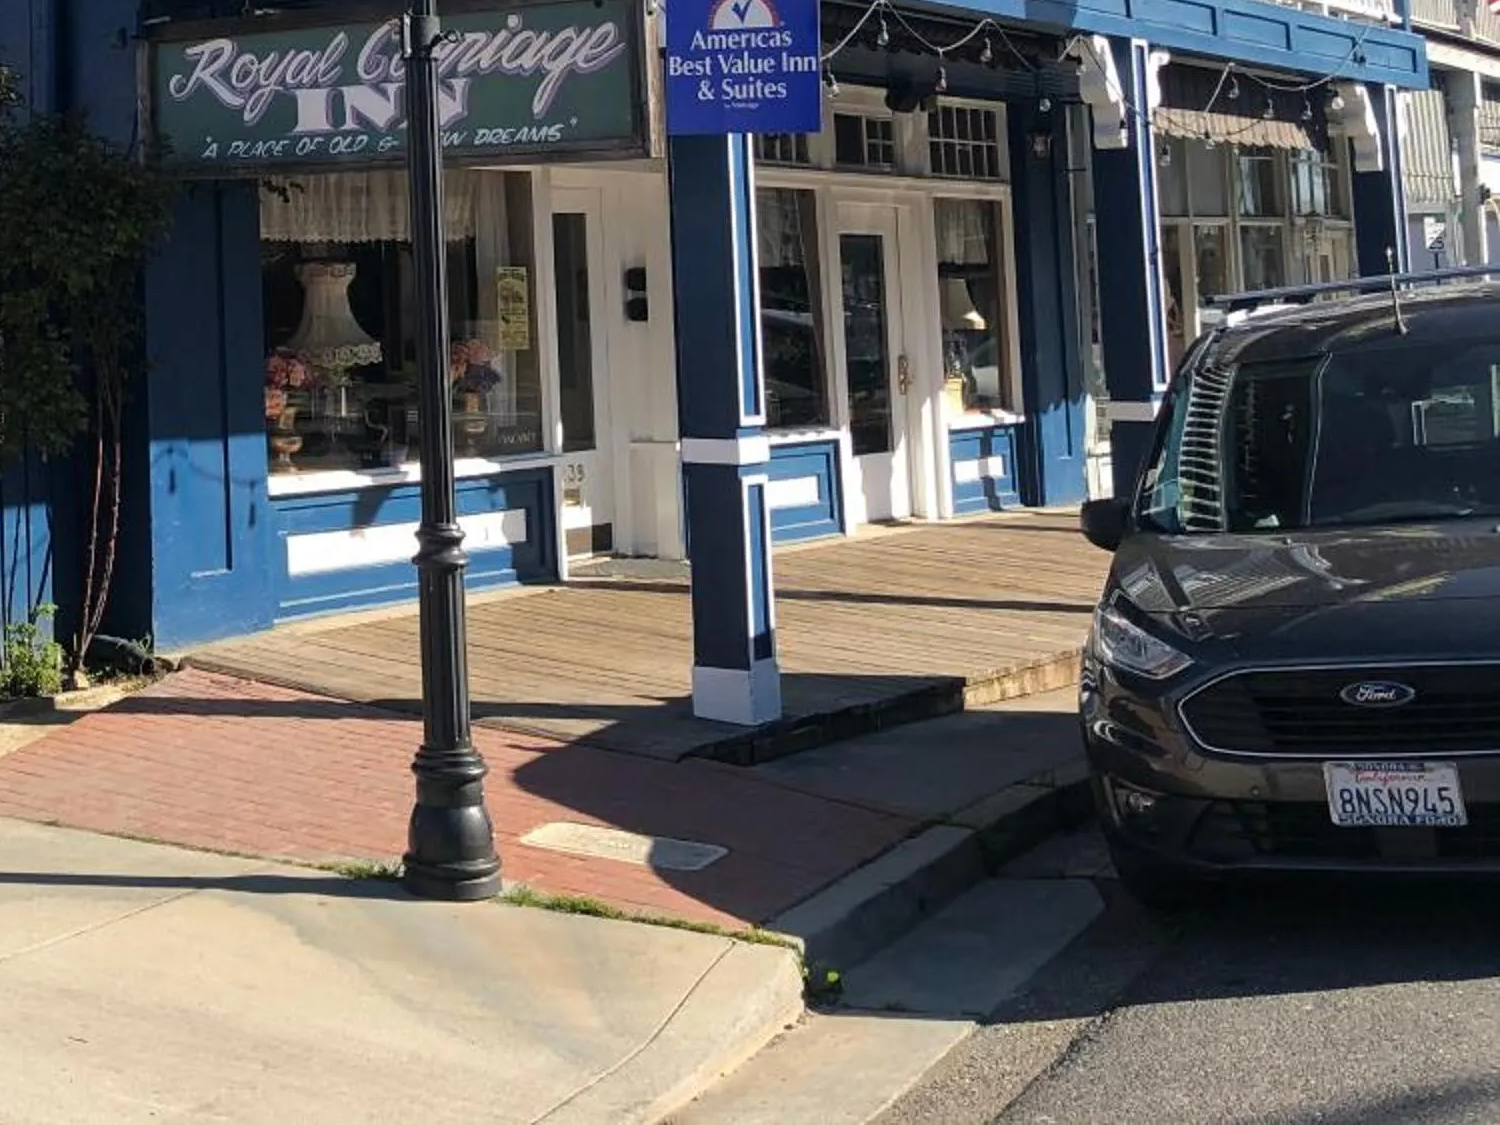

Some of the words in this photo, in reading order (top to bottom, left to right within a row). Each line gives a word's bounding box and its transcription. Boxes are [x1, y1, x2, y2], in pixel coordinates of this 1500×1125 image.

[690, 30, 793, 50] Americas
[669, 55, 712, 76] Best
[717, 51, 776, 74] Value
[781, 51, 817, 72] Inn
[169, 29, 348, 126] Royal
[697, 78, 715, 100] &
[721, 76, 787, 100] Suites
[227, 139, 290, 159] PLACE
[296, 136, 324, 155] OF
[329, 134, 370, 154] OLD
[1356, 683, 1396, 701] Ford
[1339, 787, 1455, 815] 8NSN945
